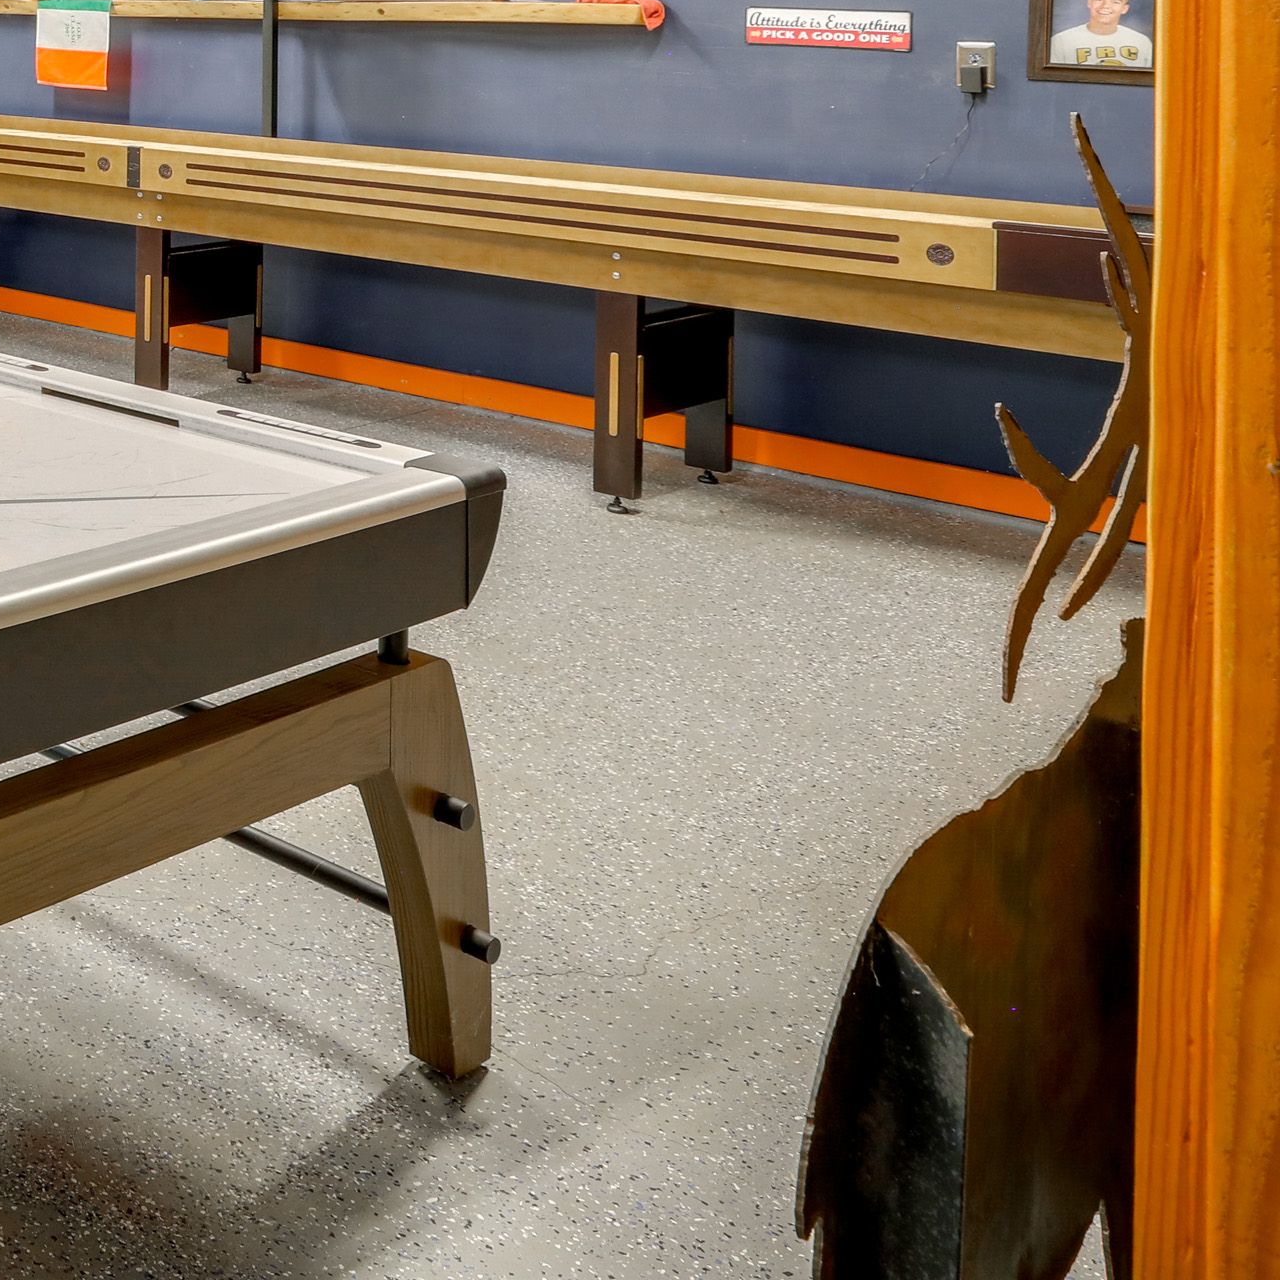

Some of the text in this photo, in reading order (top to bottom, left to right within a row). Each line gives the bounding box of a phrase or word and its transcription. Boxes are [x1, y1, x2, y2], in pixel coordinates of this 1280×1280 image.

[749, 11, 908, 34] Attitude is Everything
[762, 29, 890, 44] PICK A GOOD ONE
